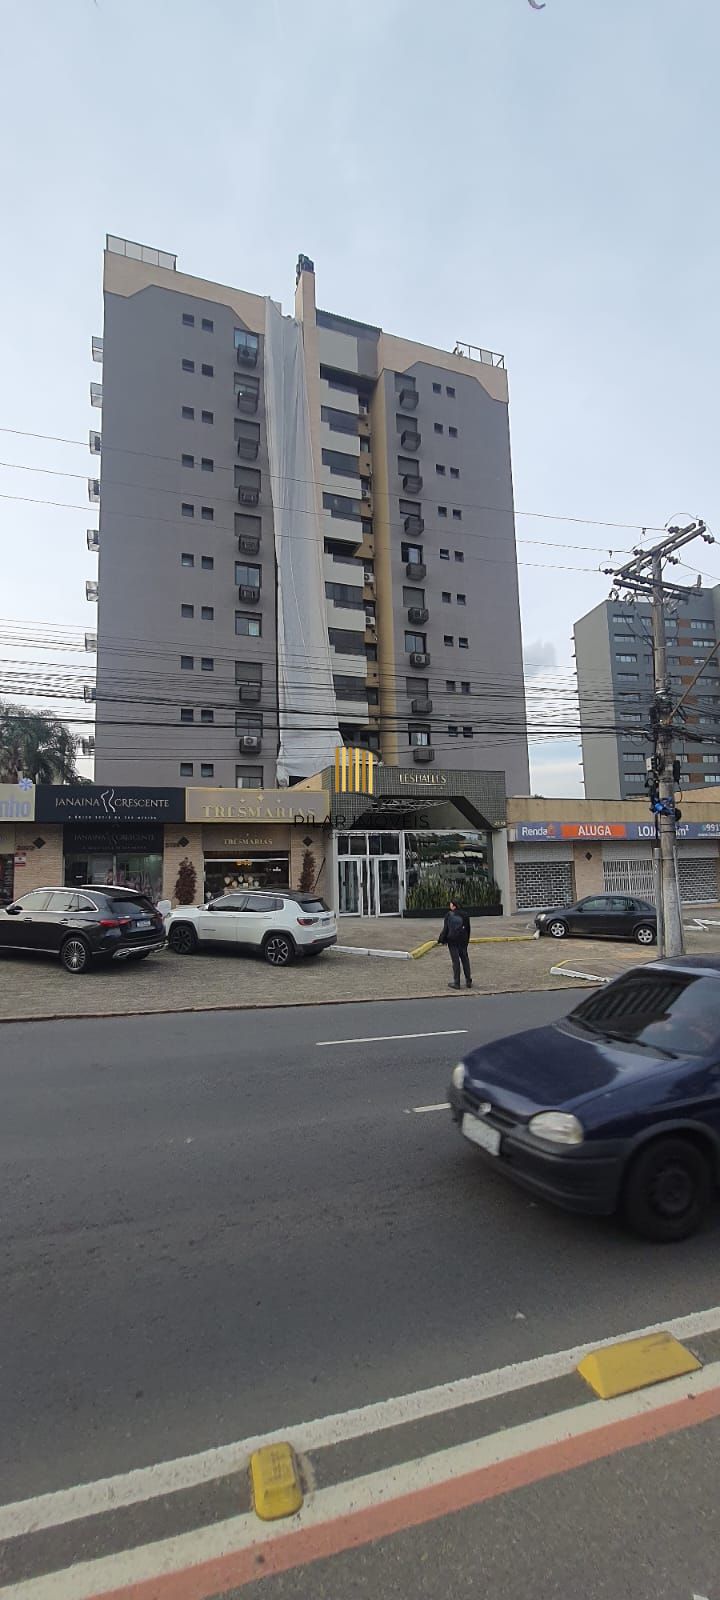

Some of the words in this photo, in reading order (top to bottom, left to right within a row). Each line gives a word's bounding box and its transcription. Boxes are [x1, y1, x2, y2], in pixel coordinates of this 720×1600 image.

[55, 797, 100, 807] JANAINA
[114, 798, 169, 808] CRESCENTE
[521, 826, 548, 836] Renda
[578, 825, 612, 836] ALUGA
